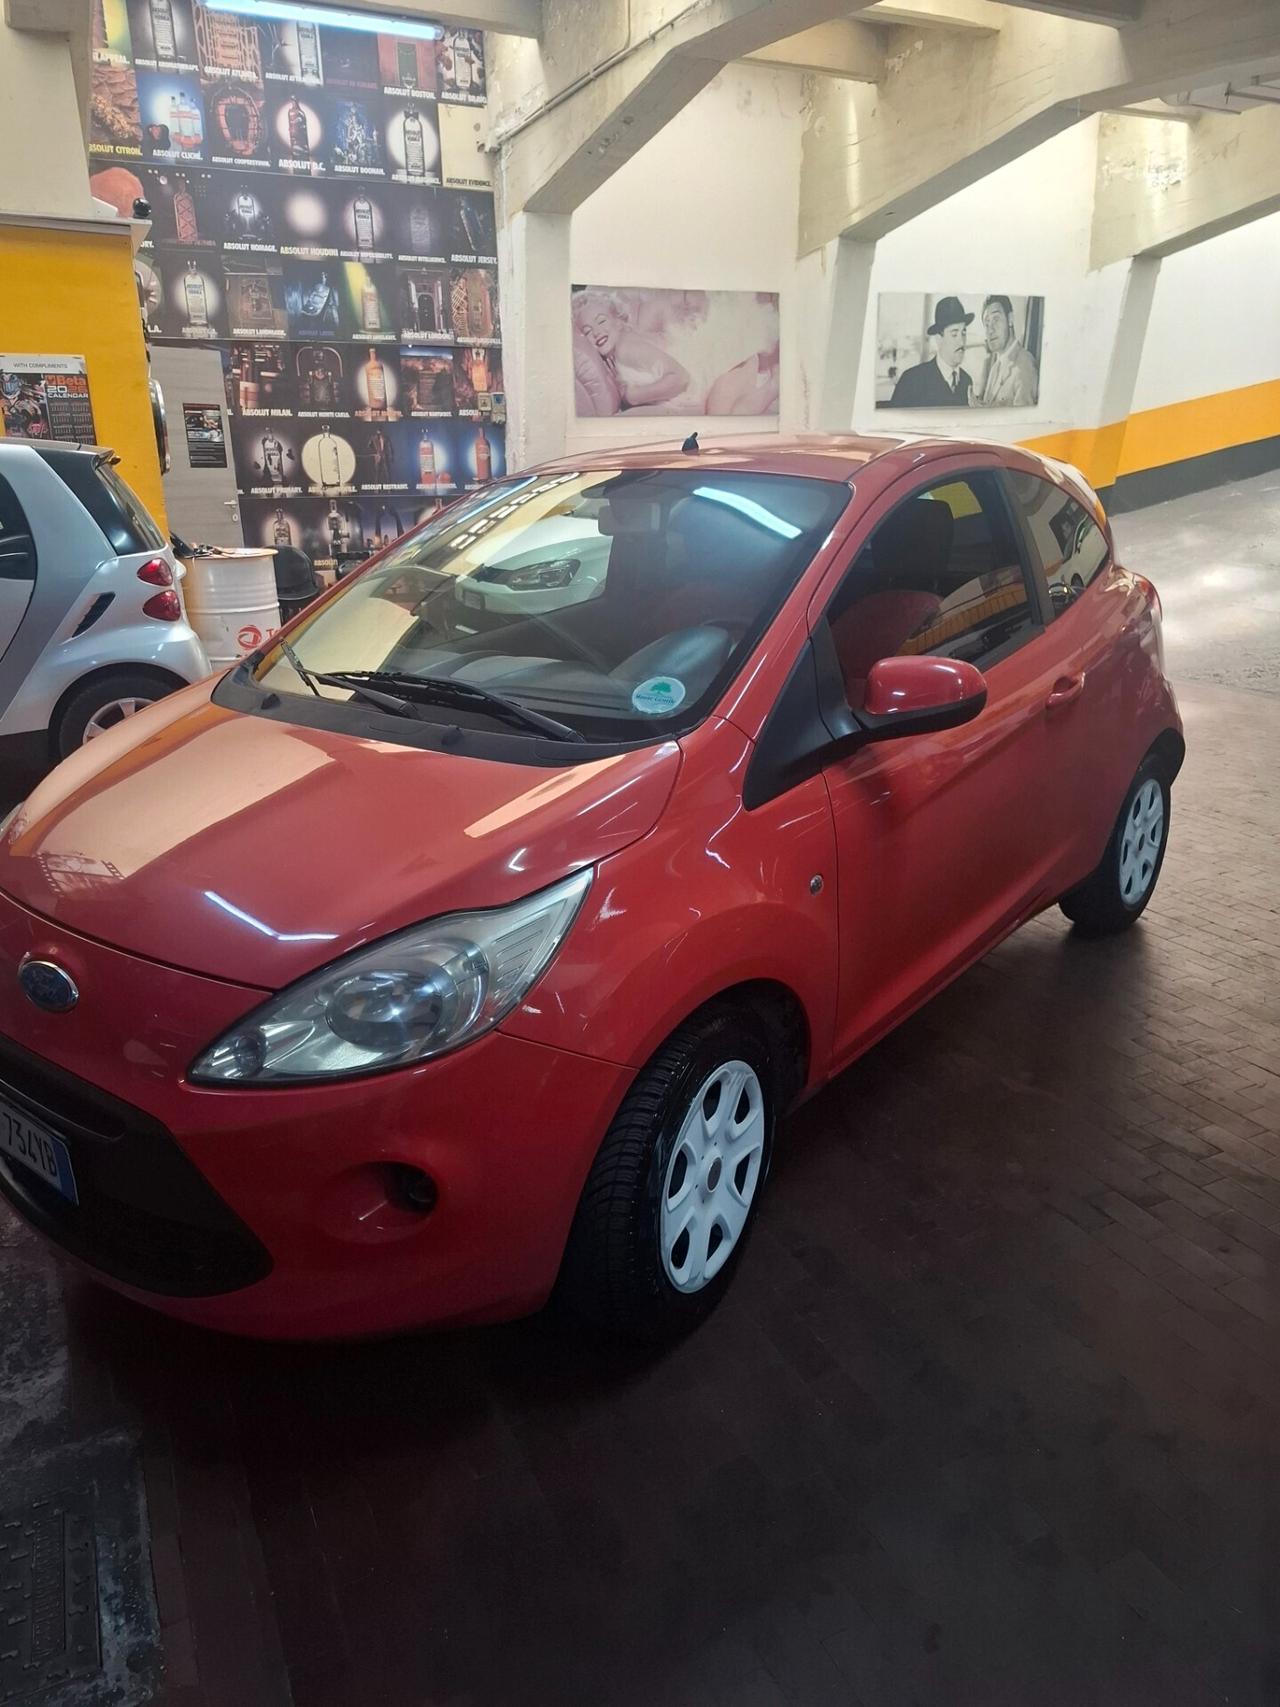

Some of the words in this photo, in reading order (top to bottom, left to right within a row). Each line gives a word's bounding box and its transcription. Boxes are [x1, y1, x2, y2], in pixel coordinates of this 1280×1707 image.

[384, 86, 410, 96] ABSOLUT
[441, 91, 466, 101] ABSOLUT
[153, 149, 180, 158] ABSOLUT
[279, 159, 311, 169] ABSOLUT
[334, 165, 359, 173] ABSOLUT
[224, 242, 249, 250] ABSOLUT
[280, 246, 309, 255] ABSOLUT
[451, 254, 477, 263] ABSOLUT
[57, 375, 86, 385] Beta
[242, 408, 269, 416] ABSOLUT
